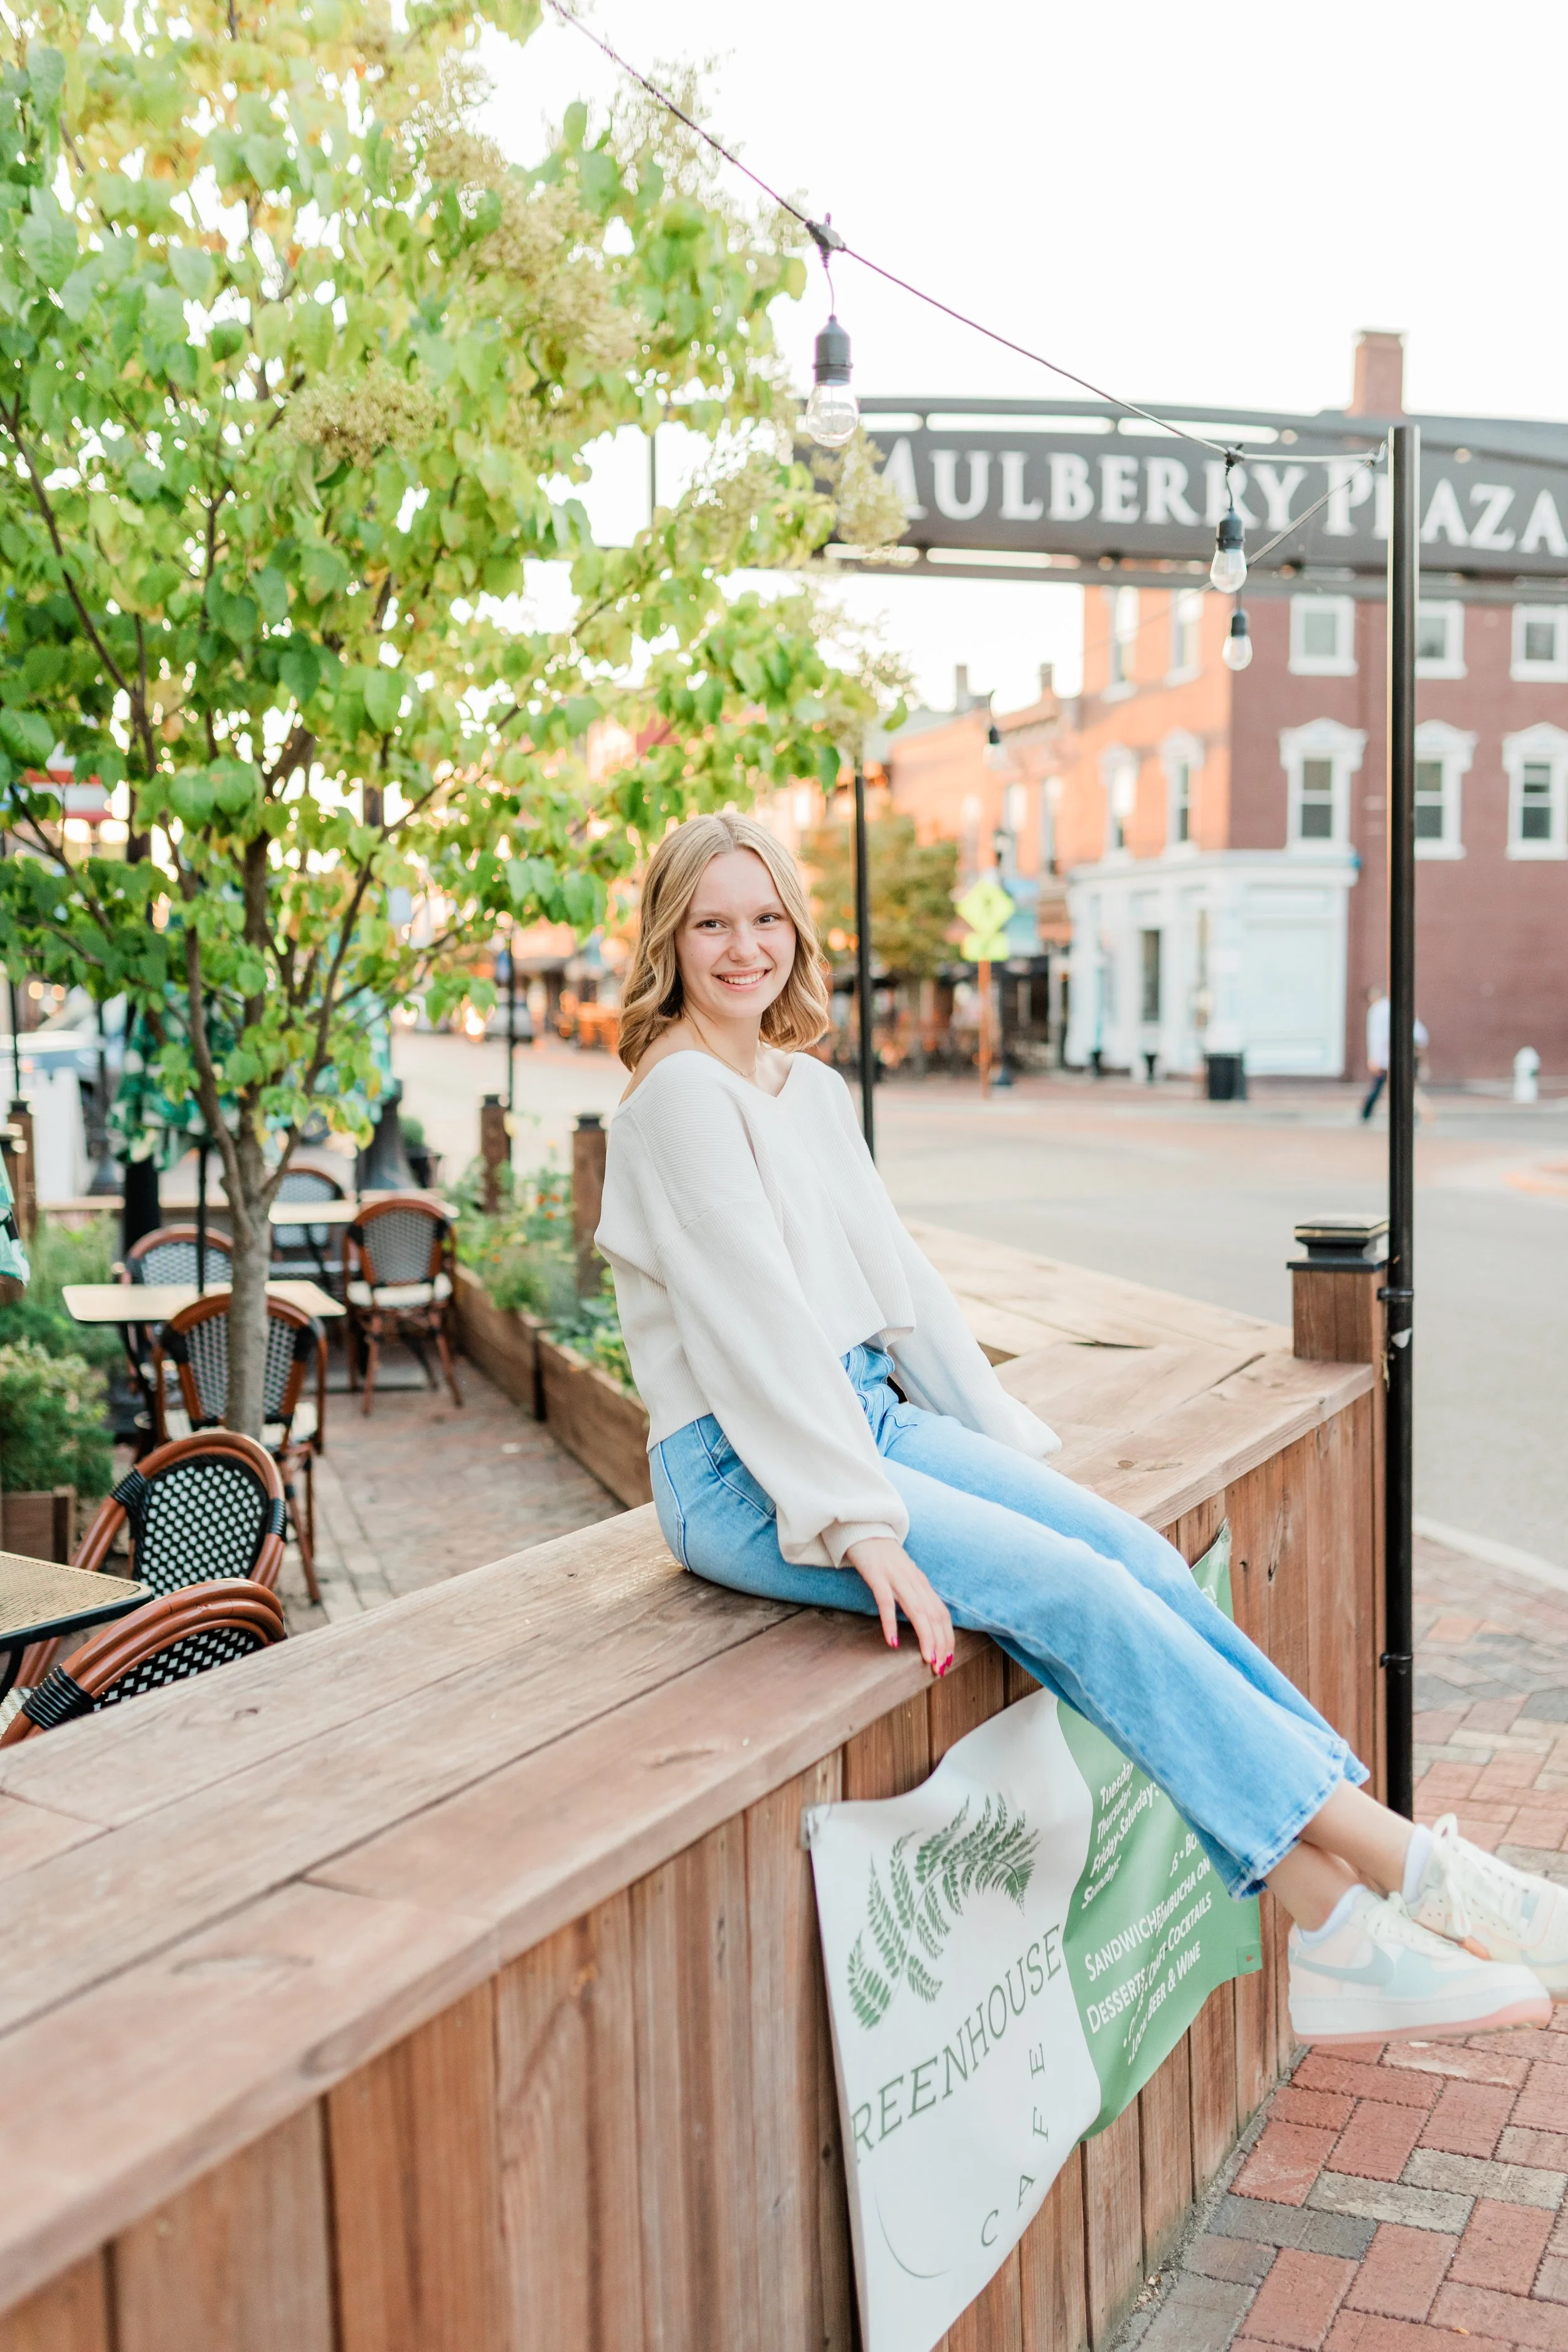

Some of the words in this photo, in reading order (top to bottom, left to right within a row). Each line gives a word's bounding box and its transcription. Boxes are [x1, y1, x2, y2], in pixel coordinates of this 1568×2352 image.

[852, 1924, 1062, 2168] REENHOUSE
[1147, 1982, 1167, 2021] BEER
[1167, 1968, 1177, 1993] &
[1176, 1941, 1200, 1981] WINE
